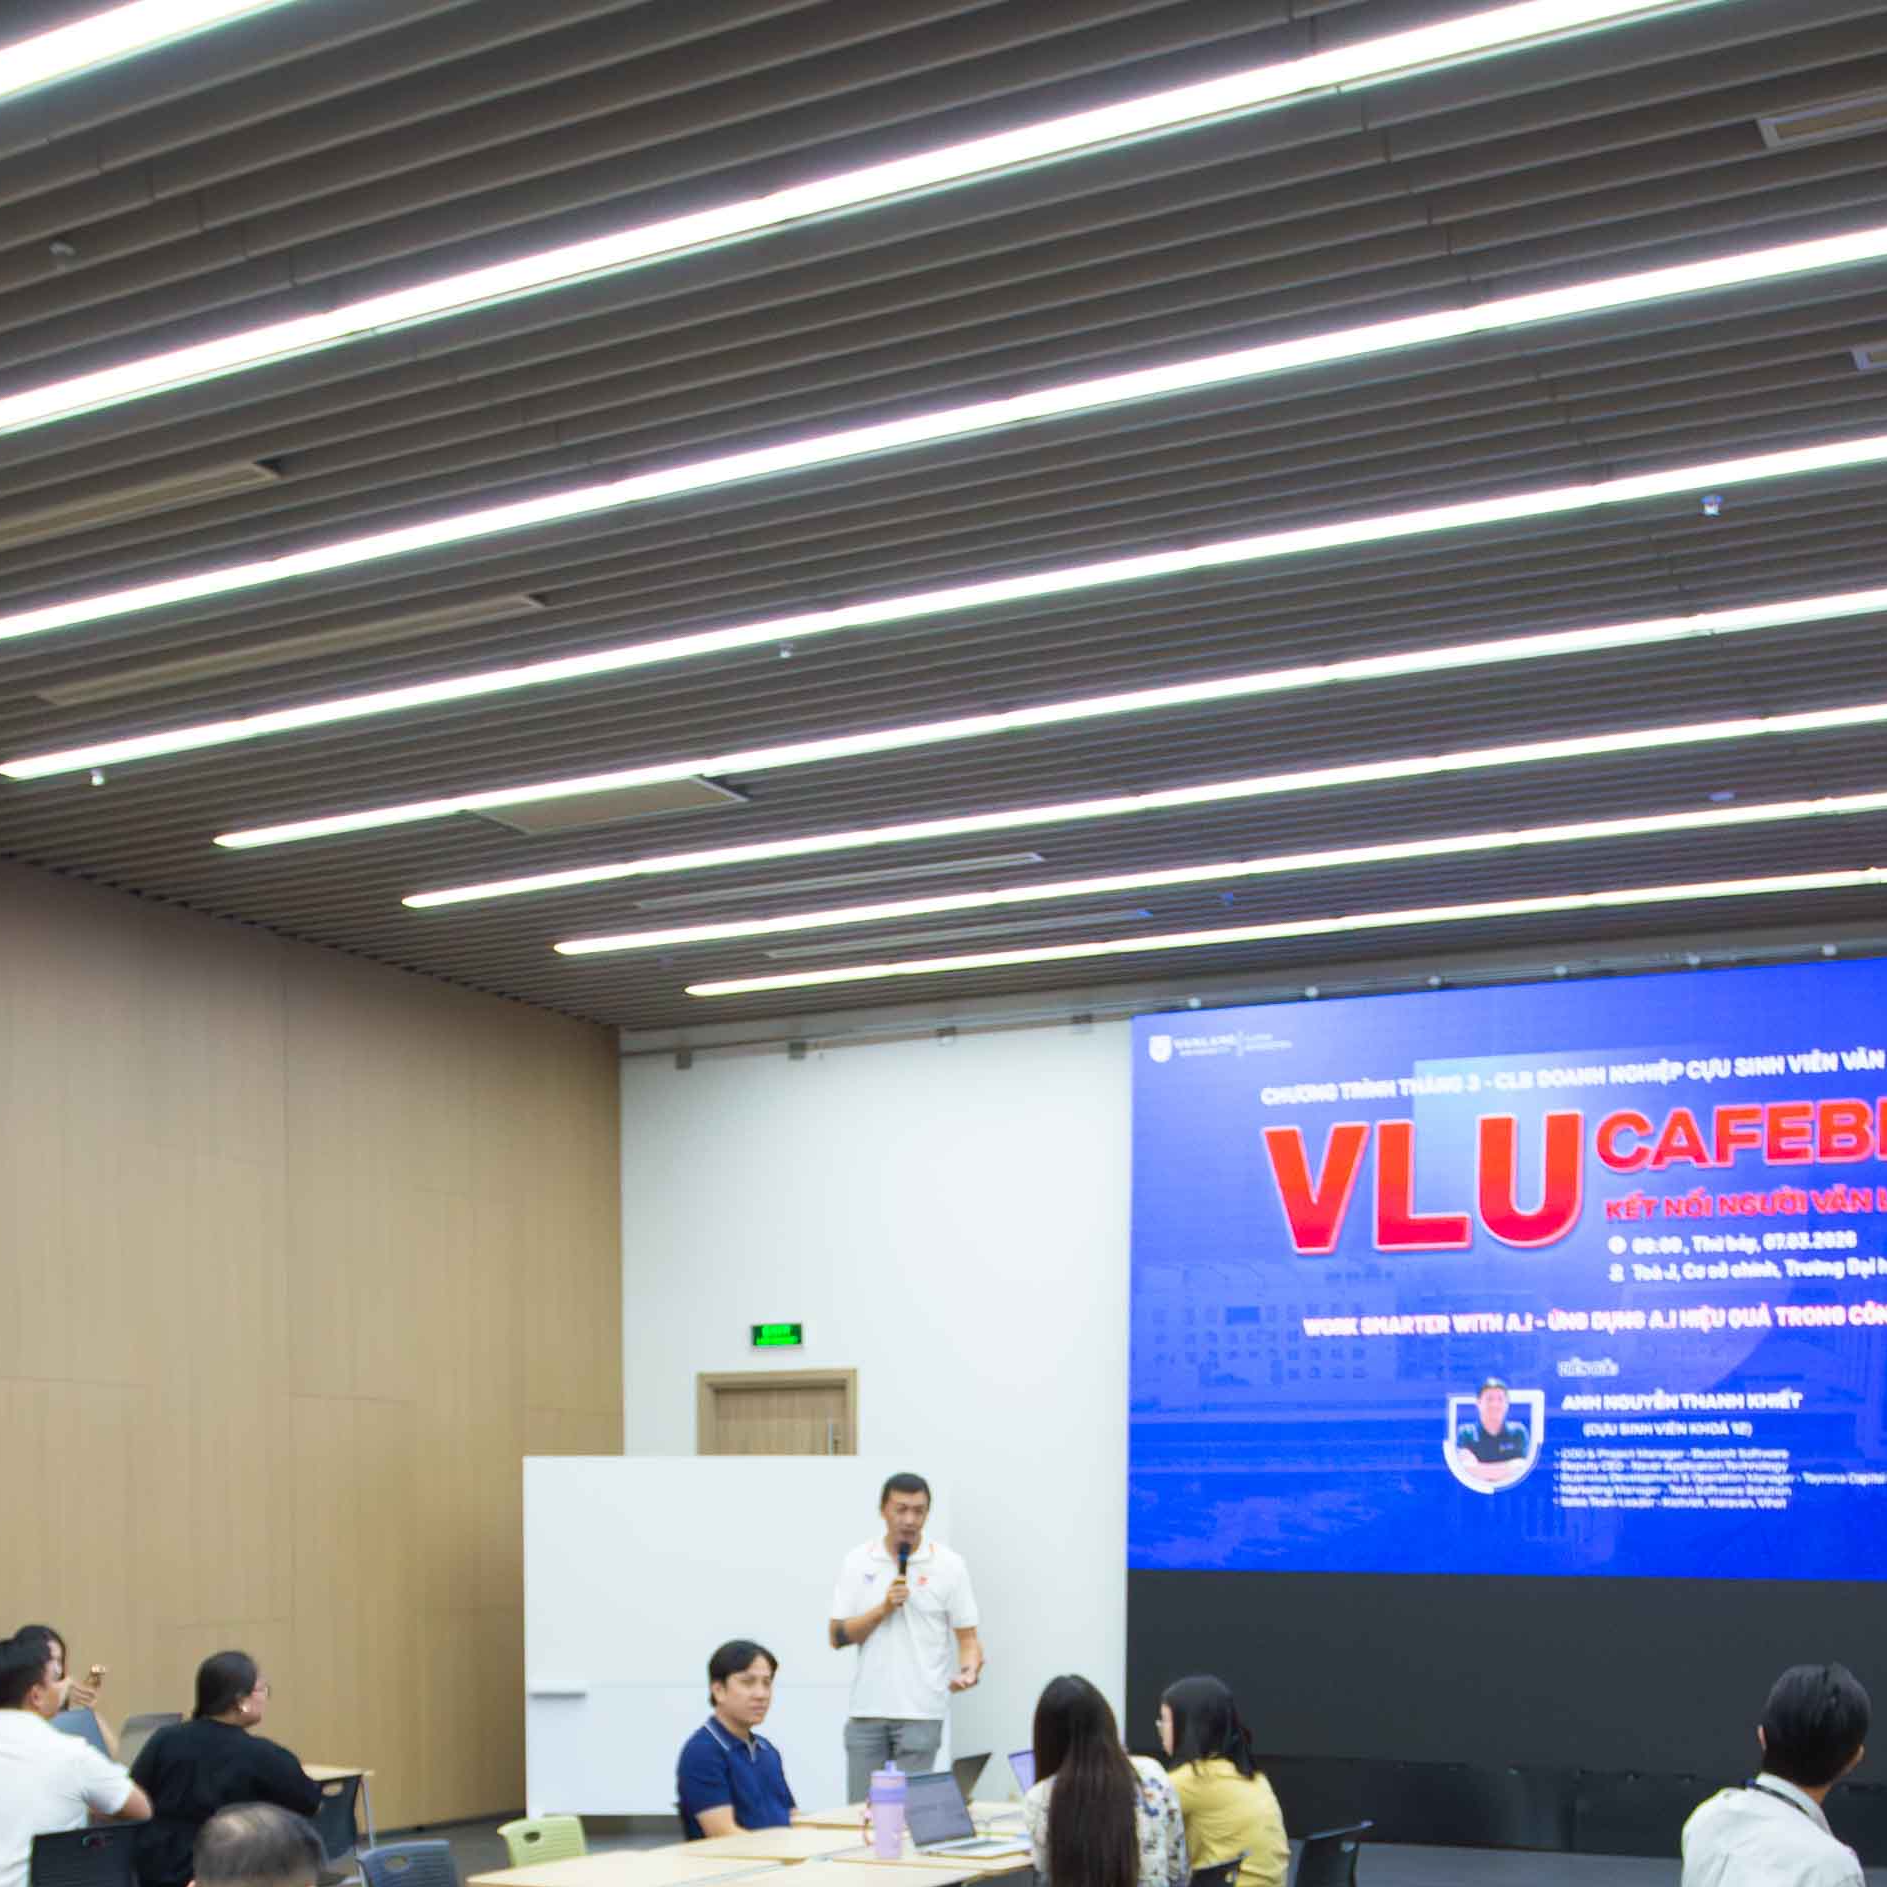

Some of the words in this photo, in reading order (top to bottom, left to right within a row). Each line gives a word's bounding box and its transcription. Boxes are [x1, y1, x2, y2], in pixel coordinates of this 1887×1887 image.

[1261, 1083, 1338, 1105] CHƯƠNG
[1339, 1077, 1396, 1100] TRÌNH
[1398, 1074, 1462, 1096] THÁNG
[1494, 1070, 1533, 1090] CLB
[1536, 1065, 1605, 1089] DOANH
[1608, 1058, 1684, 1086] NGHIỆP
[1685, 1058, 1731, 1083] CỰU
[1733, 1054, 1786, 1078] SINH
[1787, 1048, 1838, 1074] VIÊN
[1841, 1046, 1886, 1070] VĂN
[1261, 1109, 1584, 1255] VLU
[1605, 1188, 1658, 1222] KẾT
[1664, 1186, 1712, 1219] NỐI
[1718, 1183, 1808, 1217] NGƯỜI
[1809, 1182, 1873, 1214] VĂN
[1361, 1315, 1450, 1335] SMARTER
[1452, 1313, 1504, 1333] WITH
[1679, 1304, 1726, 1333] HIỆU
[1775, 1306, 1846, 1328] TRONG
[1561, 1394, 1602, 1411] ANH
